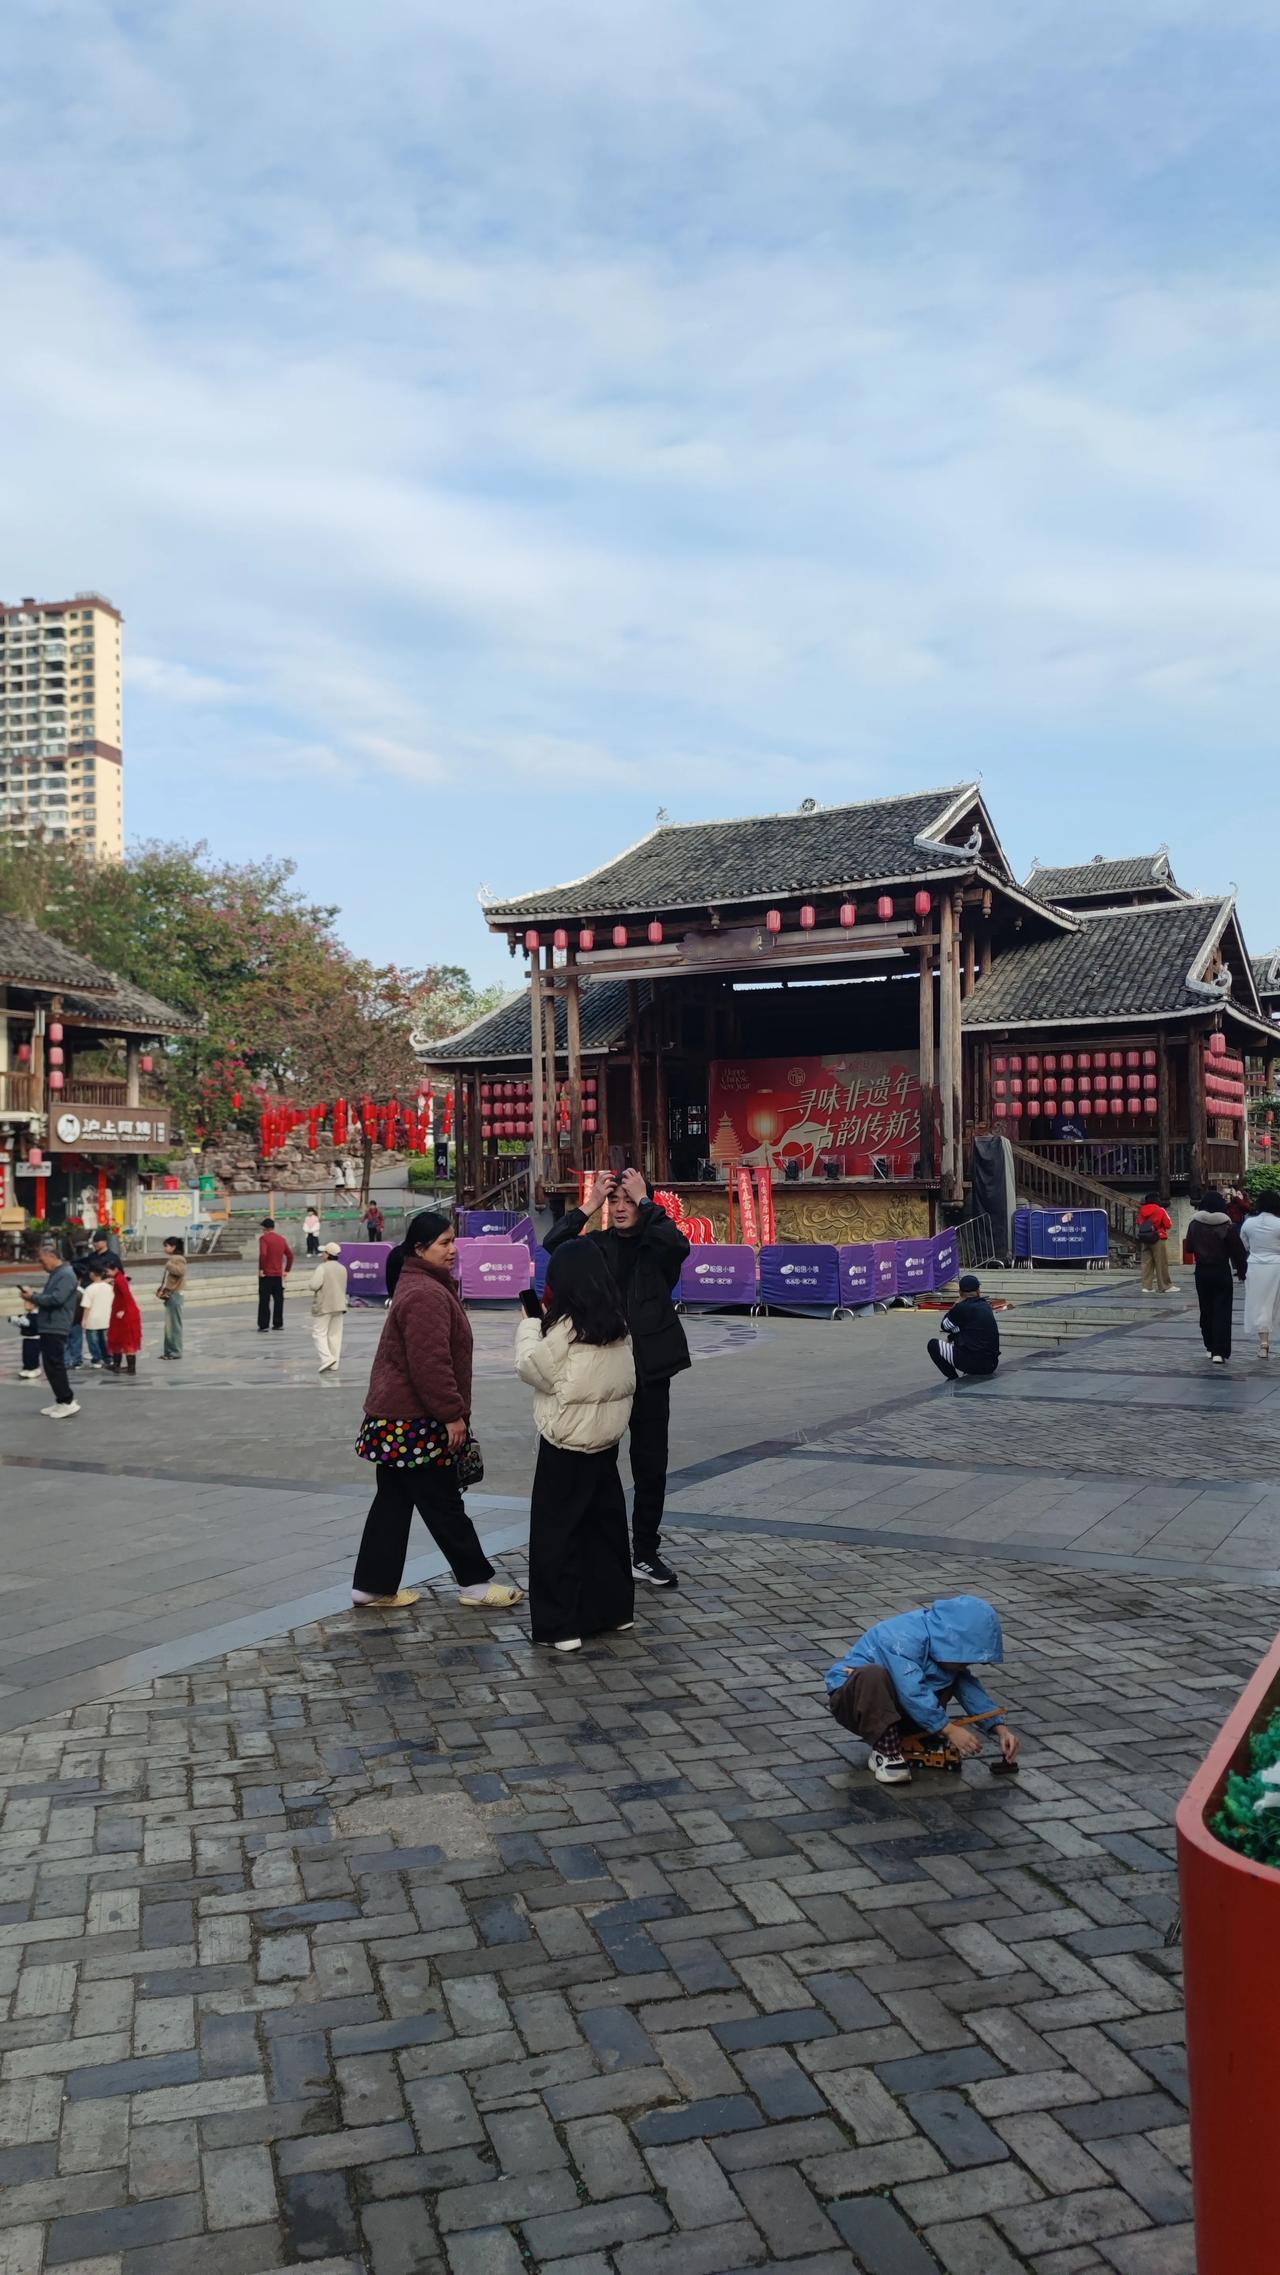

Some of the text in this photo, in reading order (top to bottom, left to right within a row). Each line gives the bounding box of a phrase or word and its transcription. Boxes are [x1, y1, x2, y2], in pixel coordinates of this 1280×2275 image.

[777, 1071, 922, 1129] 寻味非遗年
[81, 1118, 151, 1135] 沪上阿姨
